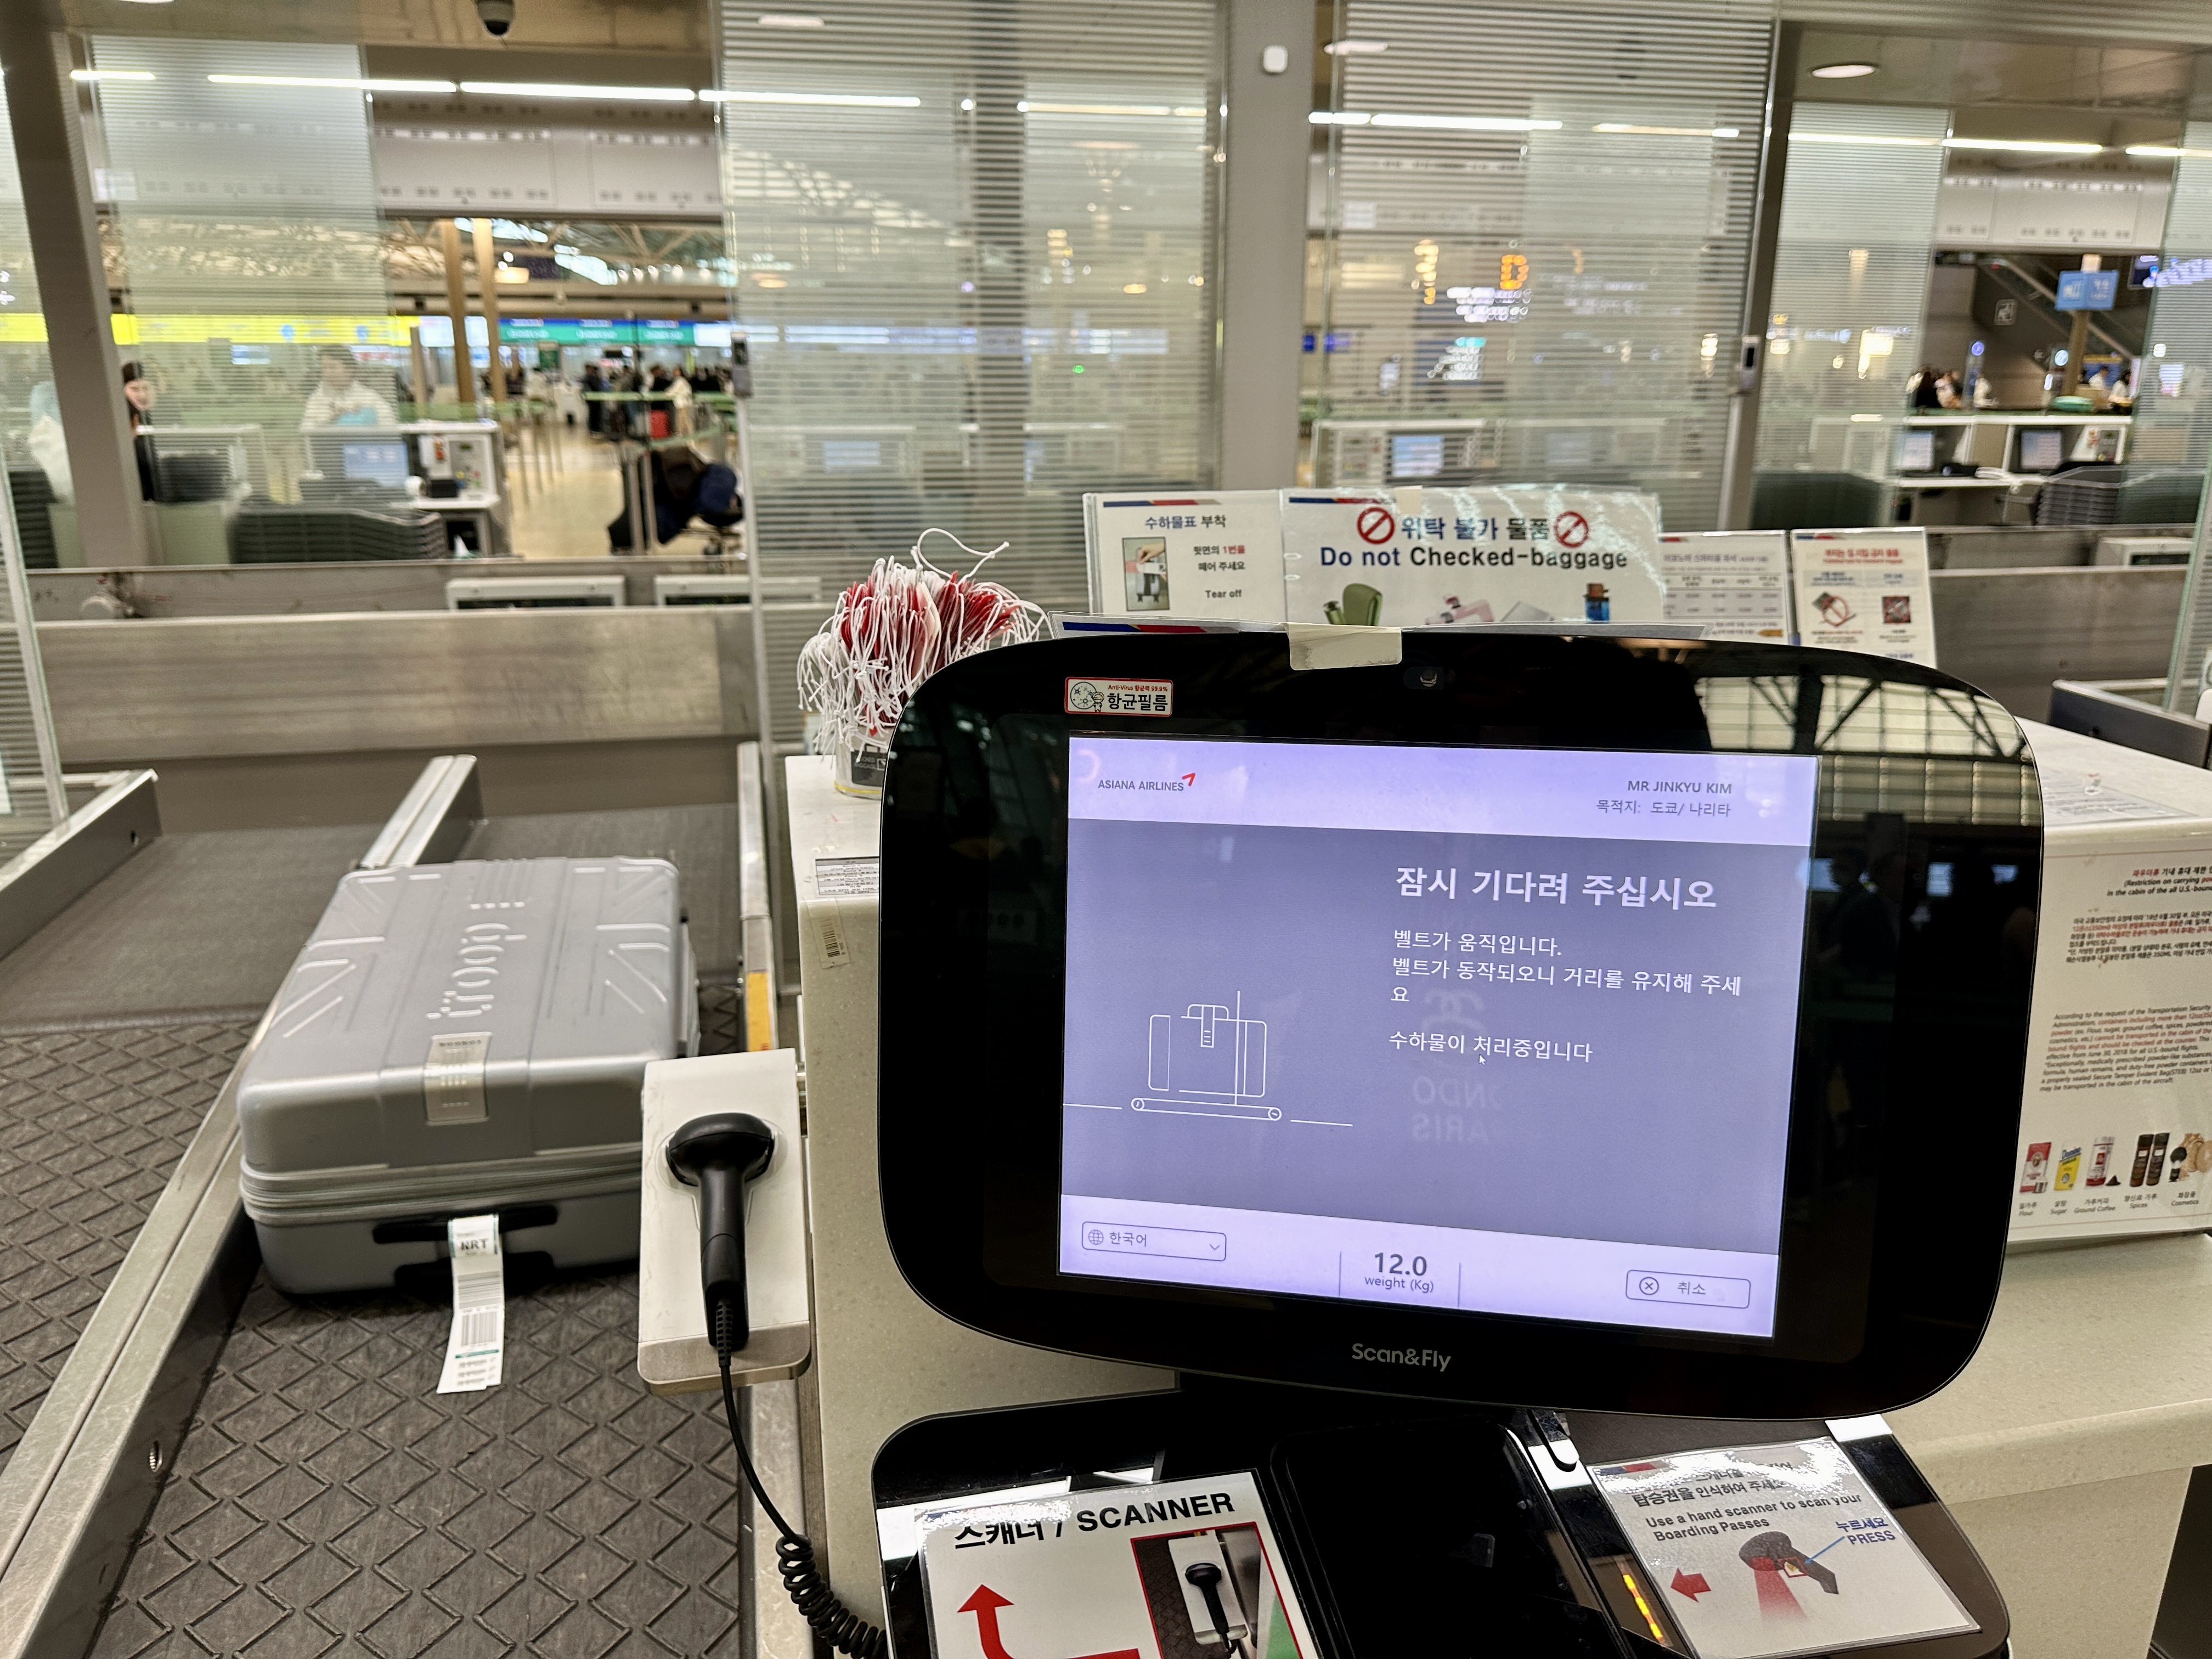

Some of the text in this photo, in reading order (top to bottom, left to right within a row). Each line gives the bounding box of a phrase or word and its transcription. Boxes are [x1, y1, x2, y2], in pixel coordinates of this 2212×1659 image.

[1145, 515, 1227, 529] 수하물표 부착
[1401, 517, 1550, 540] 위탁 불가 물품
[1218, 561, 1245, 571] 주세요
[1320, 546, 1628, 570] Do not Checked-baggage
[1107, 693, 1168, 712] 항균필름
[1098, 780, 1184, 792] ASIANA AIRLINES
[1628, 780, 1732, 794] MR JINKYU KIM
[1596, 799, 1641, 814] 목적지:
[1690, 802, 1731, 817] 나리타
[1396, 866, 1717, 911] 잠시 기다려 주십시오
[2124, 879, 2160, 888] (Restriction
[2173, 877, 2199, 885] carrying
[1393, 929, 1562, 957] 벨트가 움직입니다.
[1392, 957, 1741, 996] 벨트가 동작되오니 거리를 유지해 주세
[1390, 986, 1410, 1002] 요
[1389, 1030, 1593, 1063] 수하물이 처리중입니다
[2063, 1082, 2097, 1091] transported
[460, 1238, 489, 1250] NRT
[1109, 1232, 1147, 1247] 한국어
[1374, 1252, 1427, 1276] 12.0
[1364, 1277, 1434, 1294] weight (Kg)
[1677, 1282, 1706, 1295] 취소
[1352, 1343, 1452, 1372] Scan&Fly
[1632, 1487, 1695, 1508] 탑승권을
[1696, 1482, 1748, 1498] 인식하여
[1646, 1494, 1861, 1528] Use a hand scanner to scan your
[955, 1521, 1045, 1550] 스캐너
[1076, 1492, 1235, 1532] SCANNER
[1653, 1518, 1770, 1542] Boarding Passes
[1835, 1517, 1888, 1532] 누르세요
[1847, 1530, 1896, 1545] PRESS
